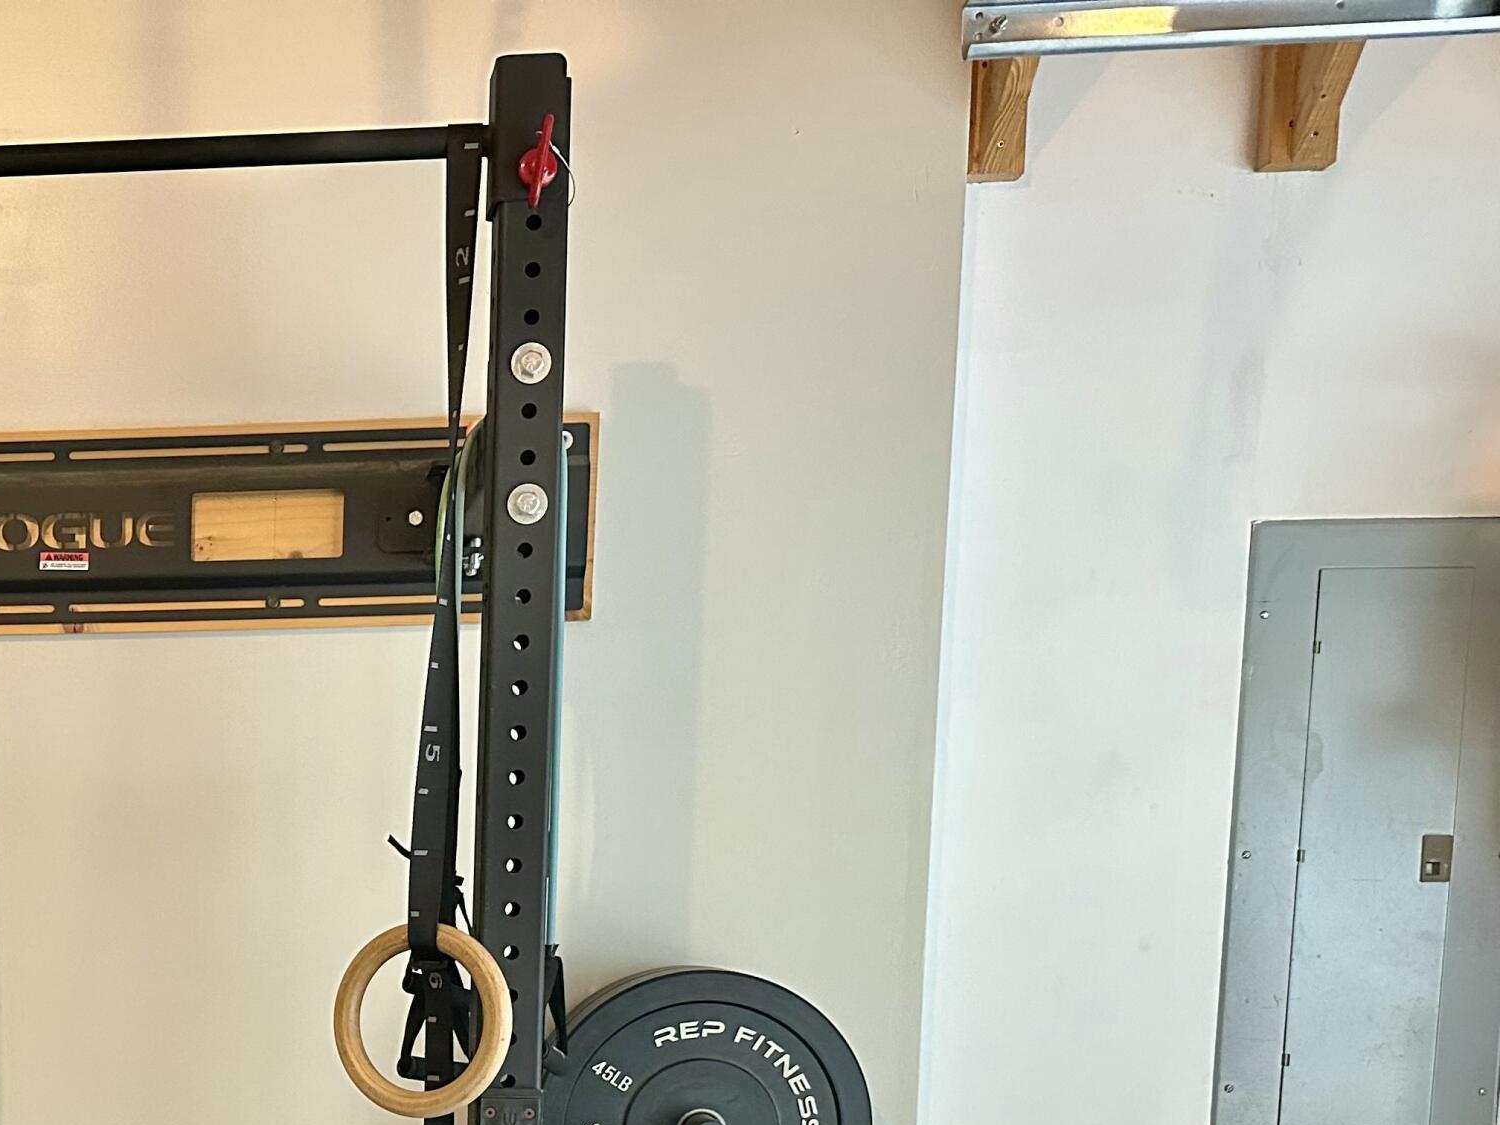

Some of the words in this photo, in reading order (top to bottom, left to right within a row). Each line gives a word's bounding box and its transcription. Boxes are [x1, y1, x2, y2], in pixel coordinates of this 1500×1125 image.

[456, 246, 469, 267] 2
[653, 1020, 725, 1048] REP
[591, 1060, 635, 1093] 45LB
